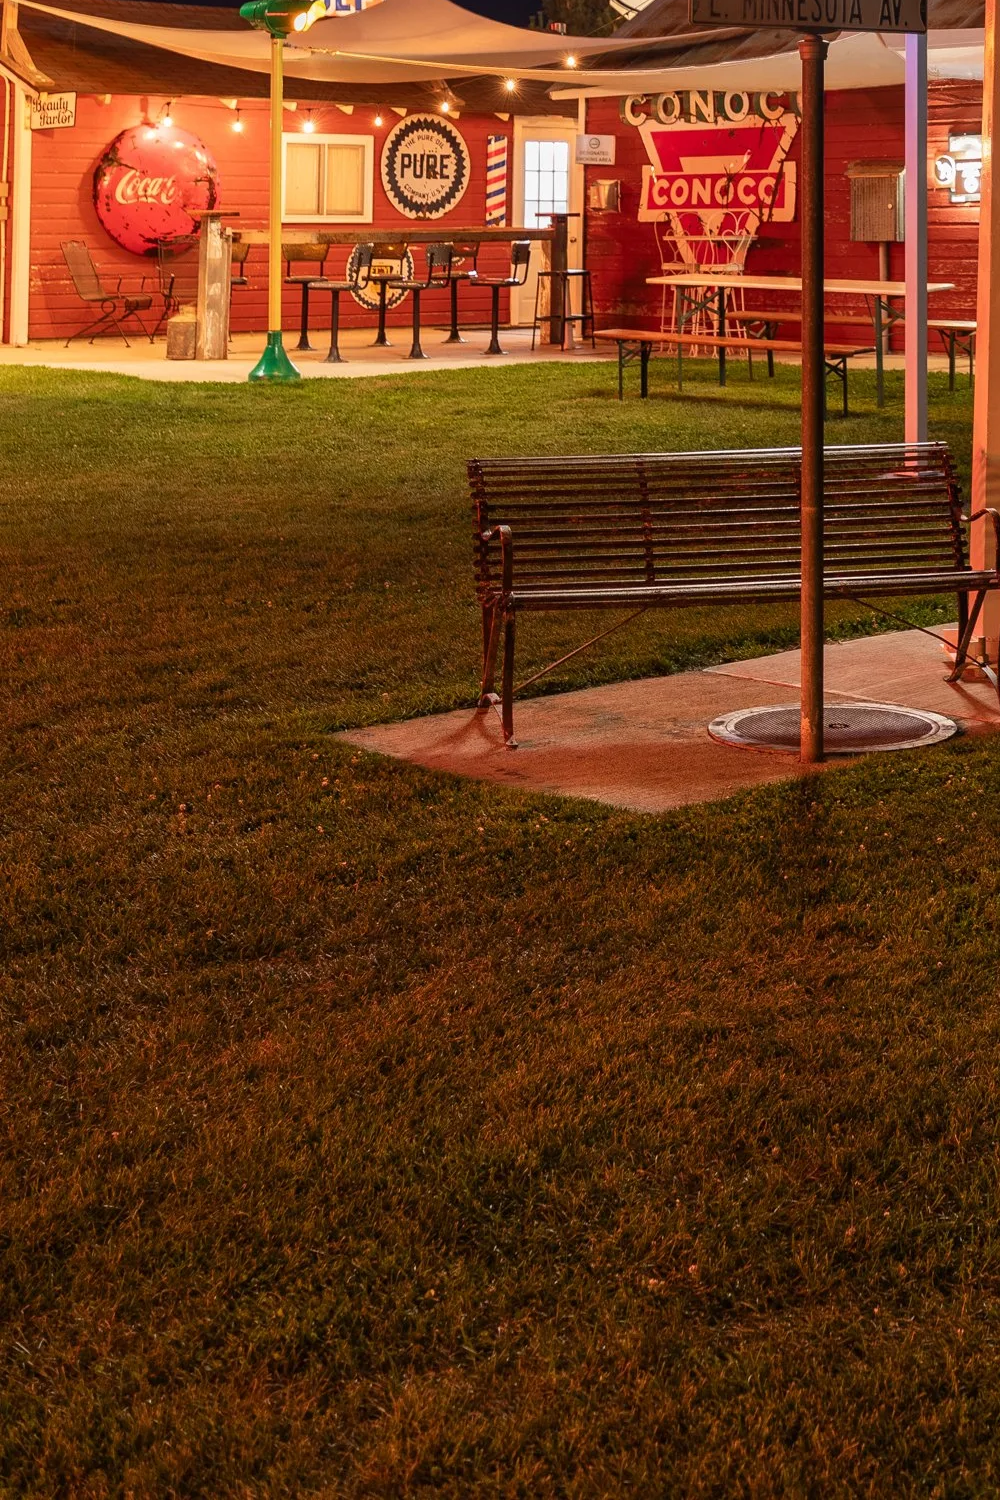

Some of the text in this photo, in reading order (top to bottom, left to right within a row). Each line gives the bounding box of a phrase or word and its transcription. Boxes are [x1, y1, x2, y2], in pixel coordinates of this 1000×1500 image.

[32, 97, 69, 113] Beauty
[623, 89, 803, 127] CONOC
[39, 110, 74, 127] Parlor
[404, 134, 445, 150] THE PURE OIL
[400, 153, 451, 180] PURE
